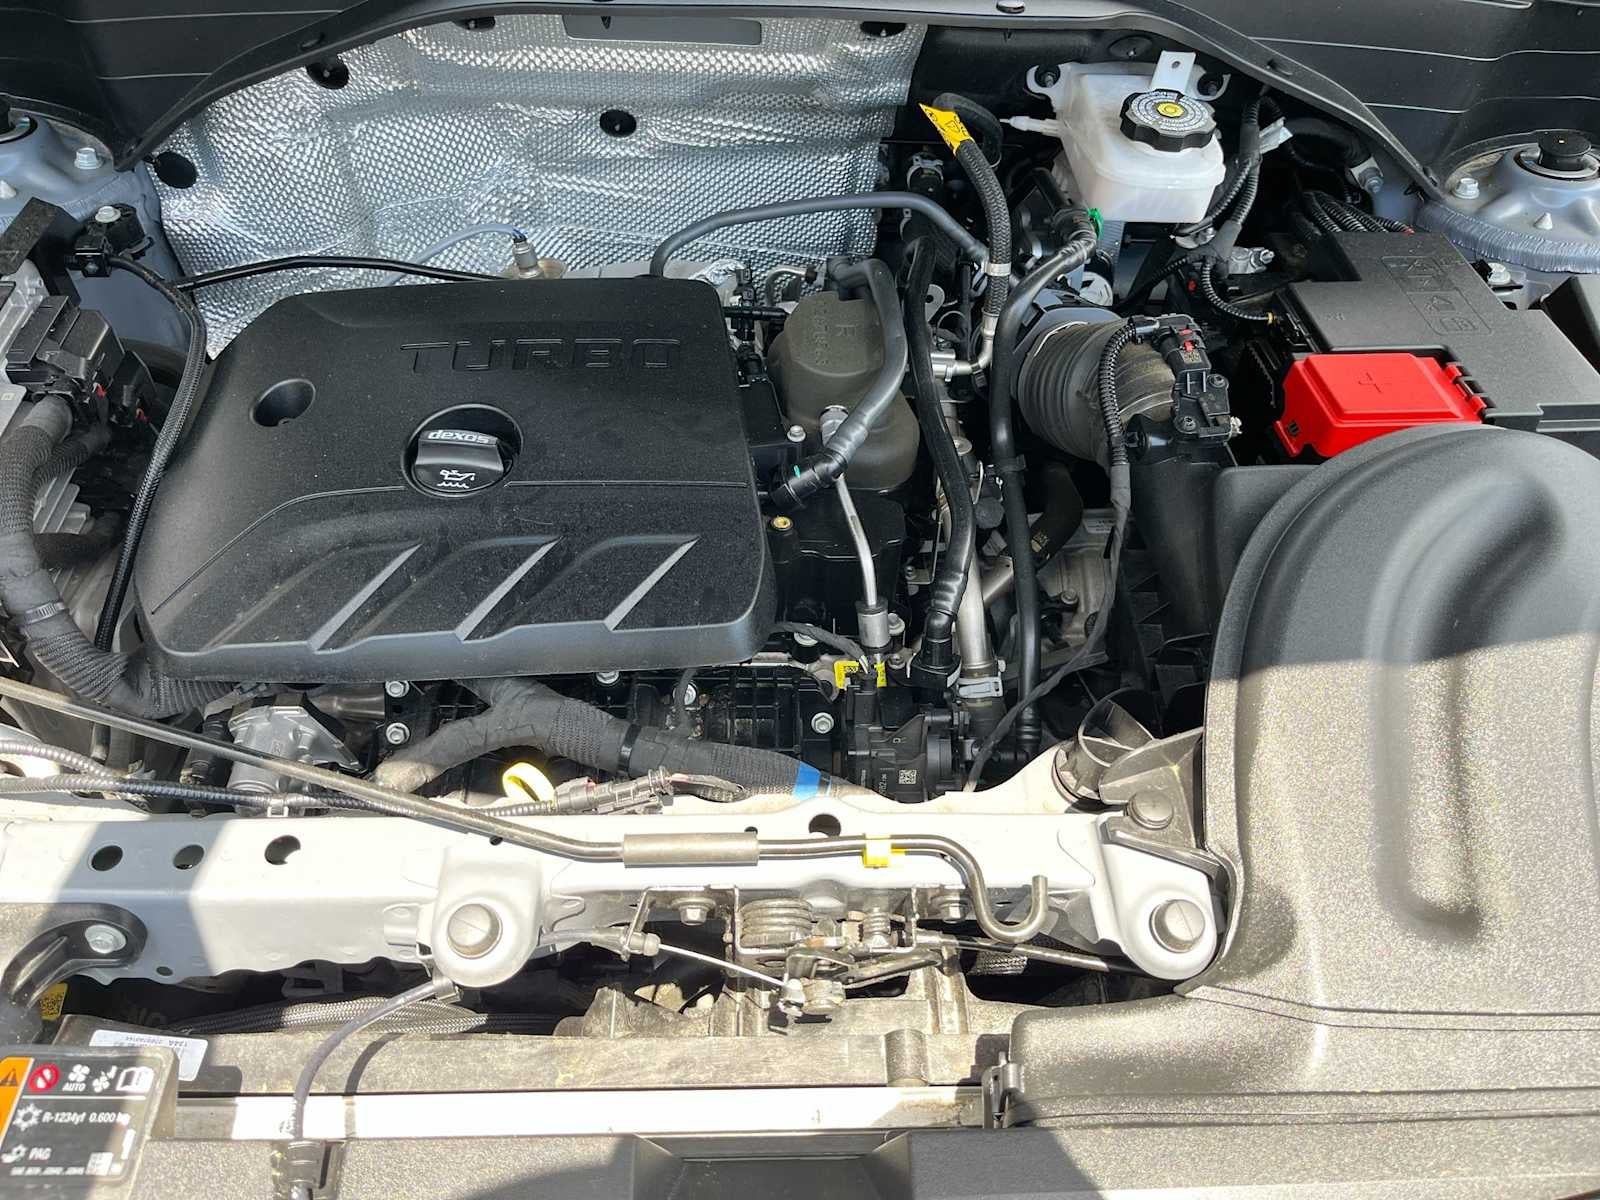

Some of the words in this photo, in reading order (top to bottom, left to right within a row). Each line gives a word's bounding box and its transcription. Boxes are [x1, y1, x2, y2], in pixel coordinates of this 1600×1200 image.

[399, 338, 680, 373] TURBO
[428, 429, 490, 444] dexos
[62, 1081, 87, 1092] AUTO
[41, 1111, 87, 1126] R-1234yf
[89, 1111, 117, 1124] 0.600
[28, 1147, 53, 1161] PAG
